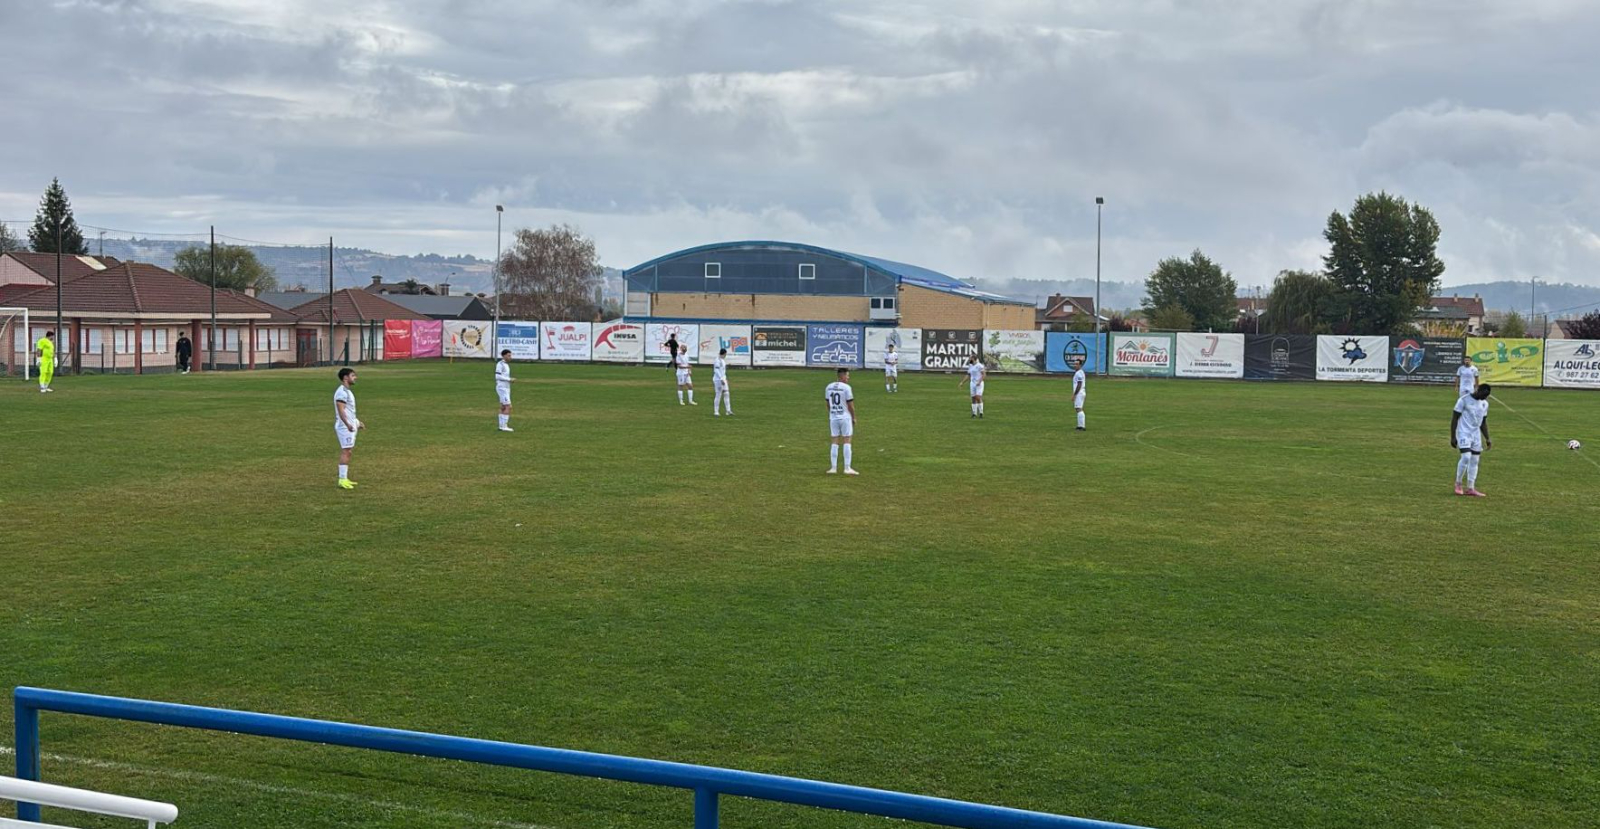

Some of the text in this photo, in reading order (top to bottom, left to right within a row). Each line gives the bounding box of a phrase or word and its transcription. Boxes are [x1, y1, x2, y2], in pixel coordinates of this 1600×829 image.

[558, 333, 587, 341] JUALPI
[926, 343, 978, 355] MARTIN
[812, 353, 858, 363] CECAR
[925, 355, 979, 368] GRANIZ
[1116, 350, 1168, 363] Montañés
[830, 392, 841, 406] 10
